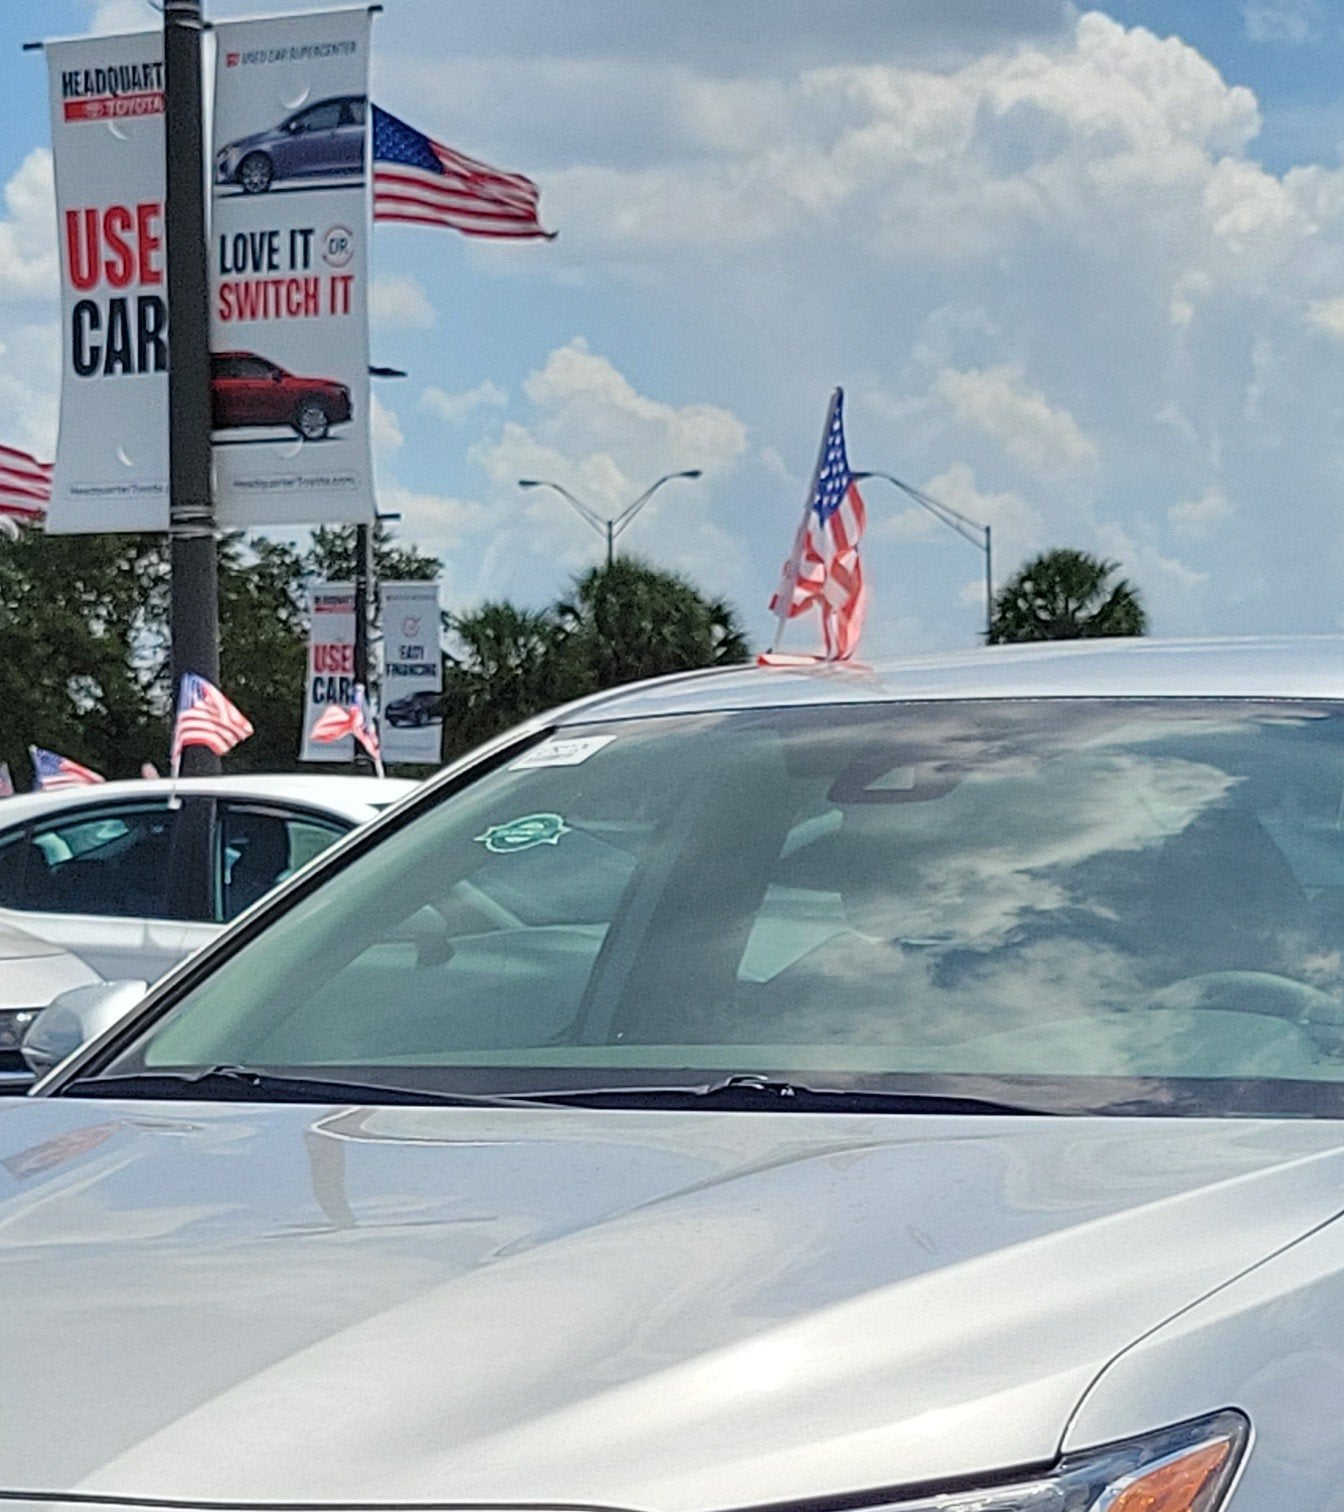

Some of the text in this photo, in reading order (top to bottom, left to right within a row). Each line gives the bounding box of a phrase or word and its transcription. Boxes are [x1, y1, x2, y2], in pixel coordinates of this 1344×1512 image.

[62, 63, 163, 98] HEADQUART
[65, 204, 163, 290] USE
[219, 228, 315, 275] LOVE IT
[328, 237, 348, 256] OR
[219, 275, 354, 323] SWITCH IT
[72, 295, 168, 378] CAR
[313, 645, 354, 673] USE
